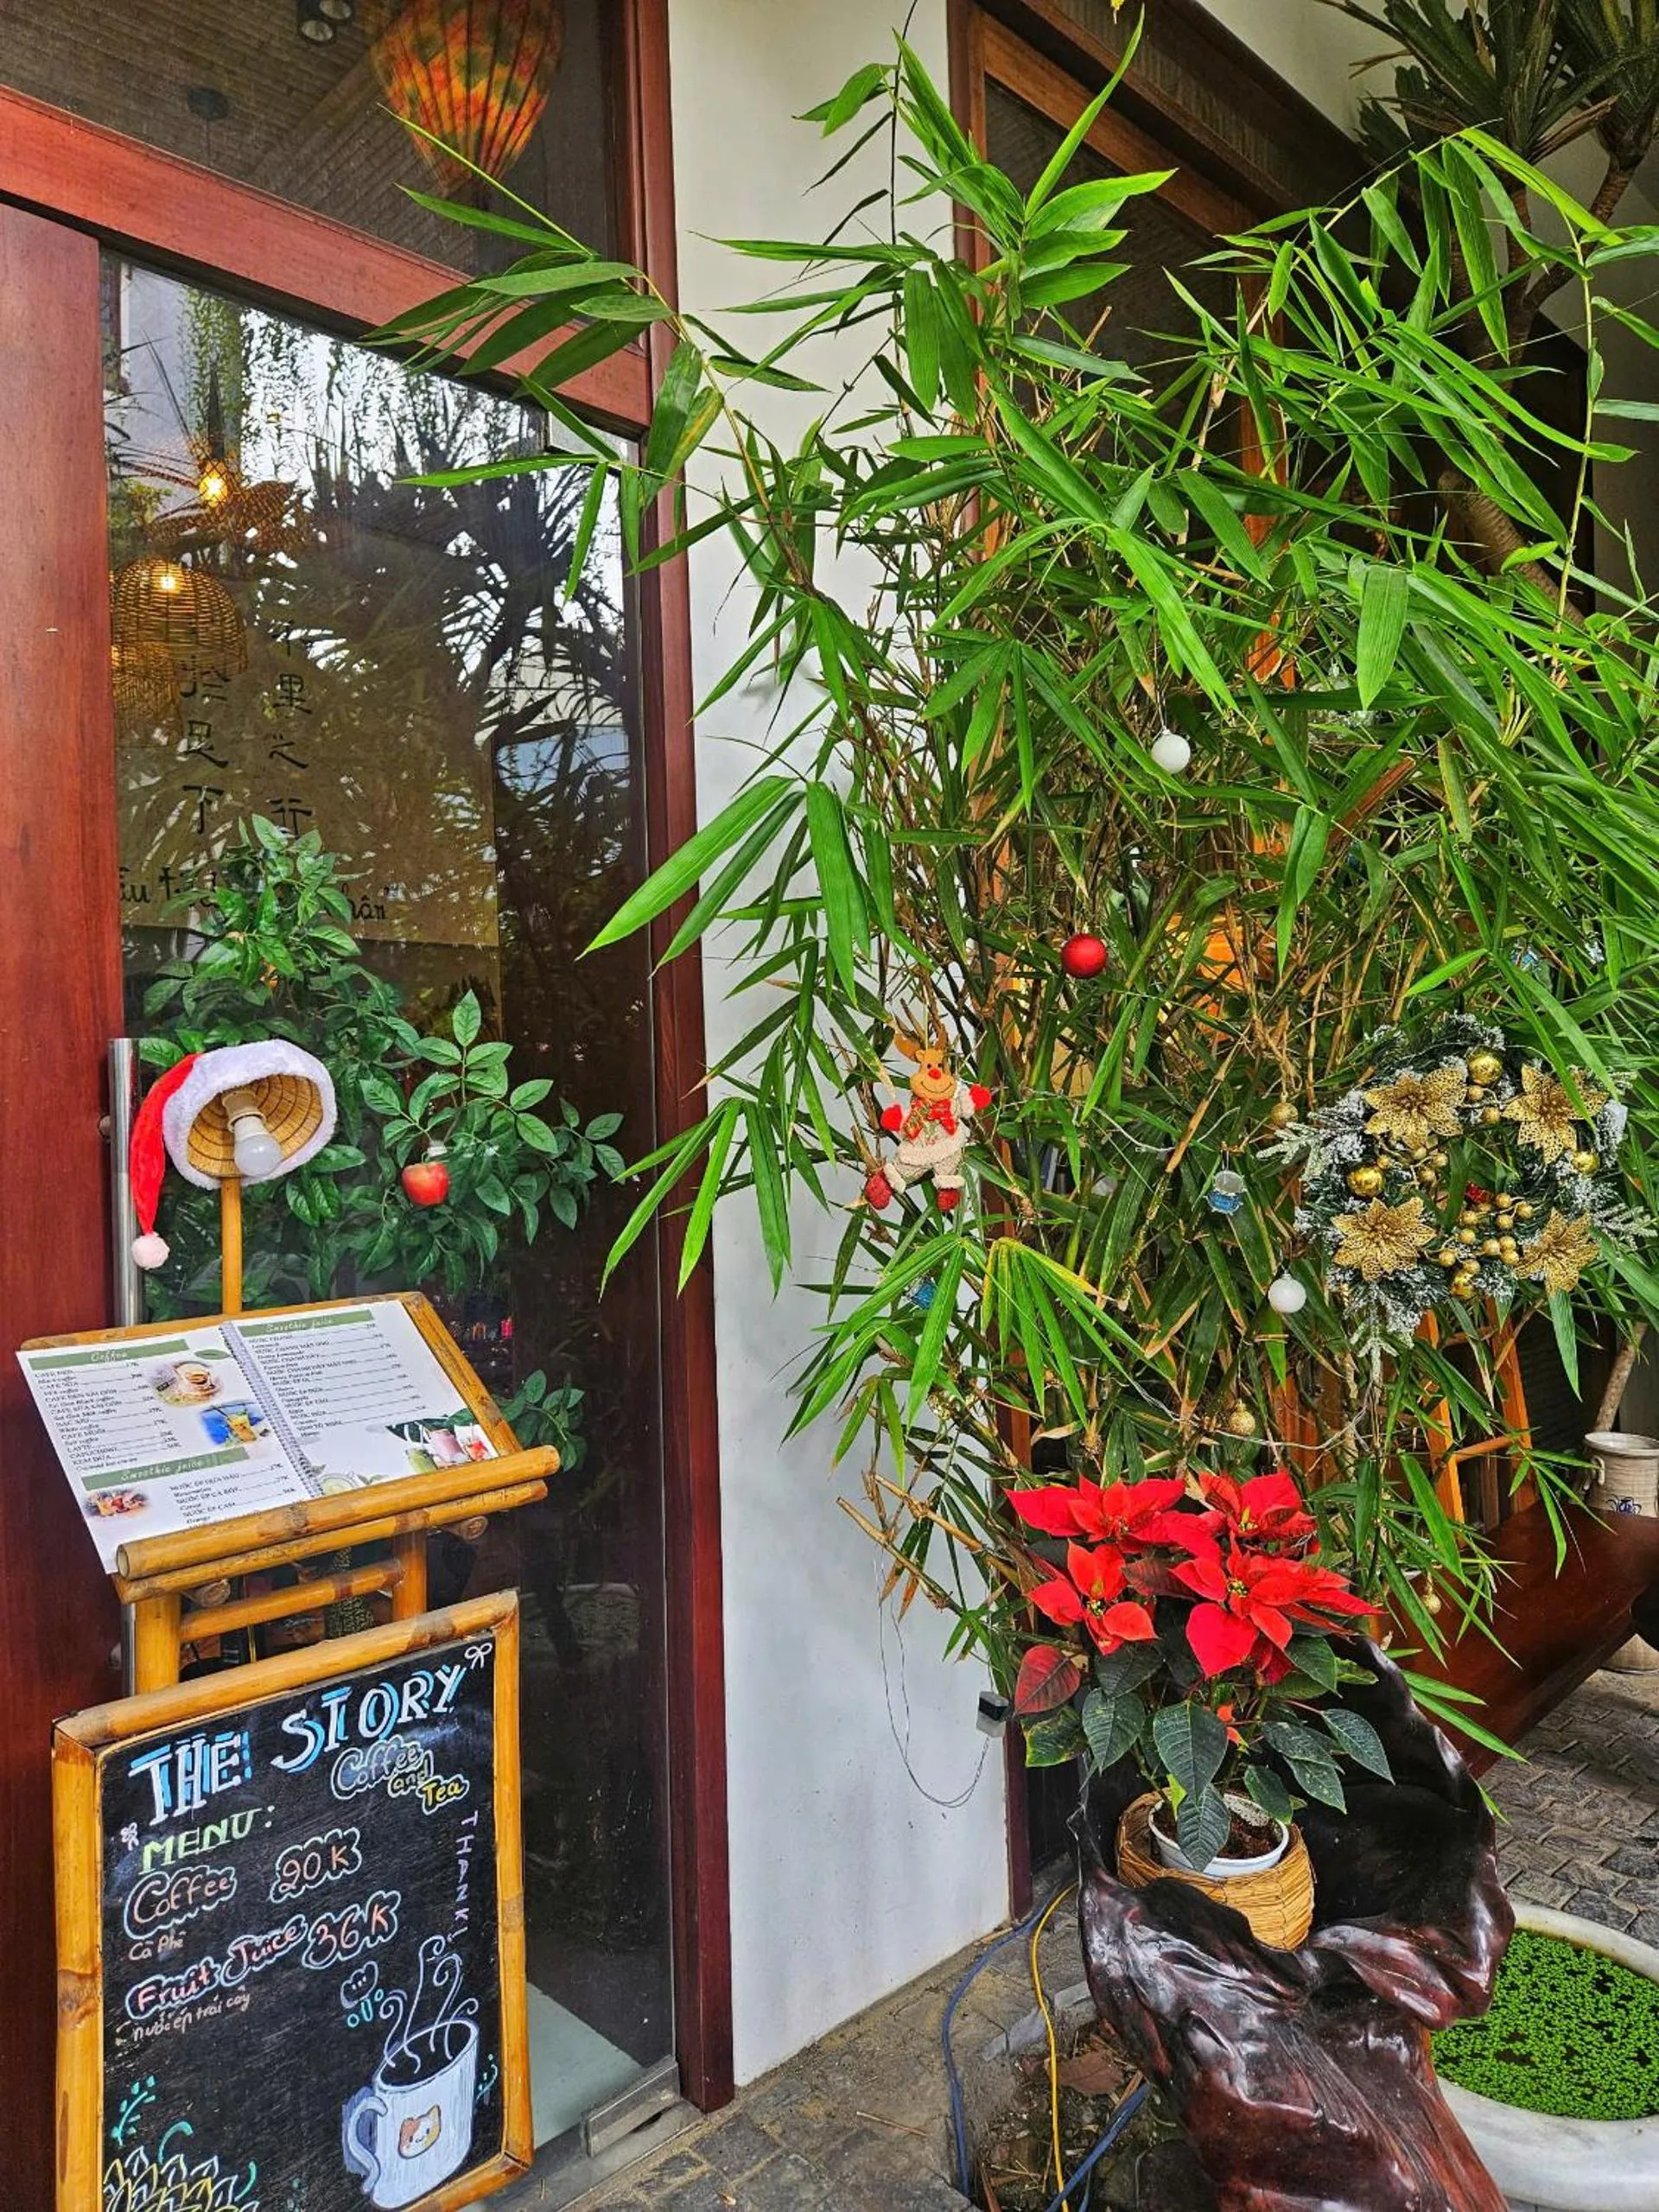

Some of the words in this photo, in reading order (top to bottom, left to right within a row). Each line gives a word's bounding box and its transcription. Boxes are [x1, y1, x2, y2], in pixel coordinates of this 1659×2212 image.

[91, 1350, 128, 1363] Coffee
[128, 1731, 252, 1827] THE
[270, 1664, 467, 1773] STORY
[334, 1736, 425, 1795] Coffee
[391, 1754, 432, 1795] and
[420, 1778, 465, 1809] Tea
[133, 1873, 234, 1927] Coffee
[137, 1966, 211, 2012] Fruit
[226, 1923, 303, 1980] Juice
[308, 1903, 389, 1963] 36K
